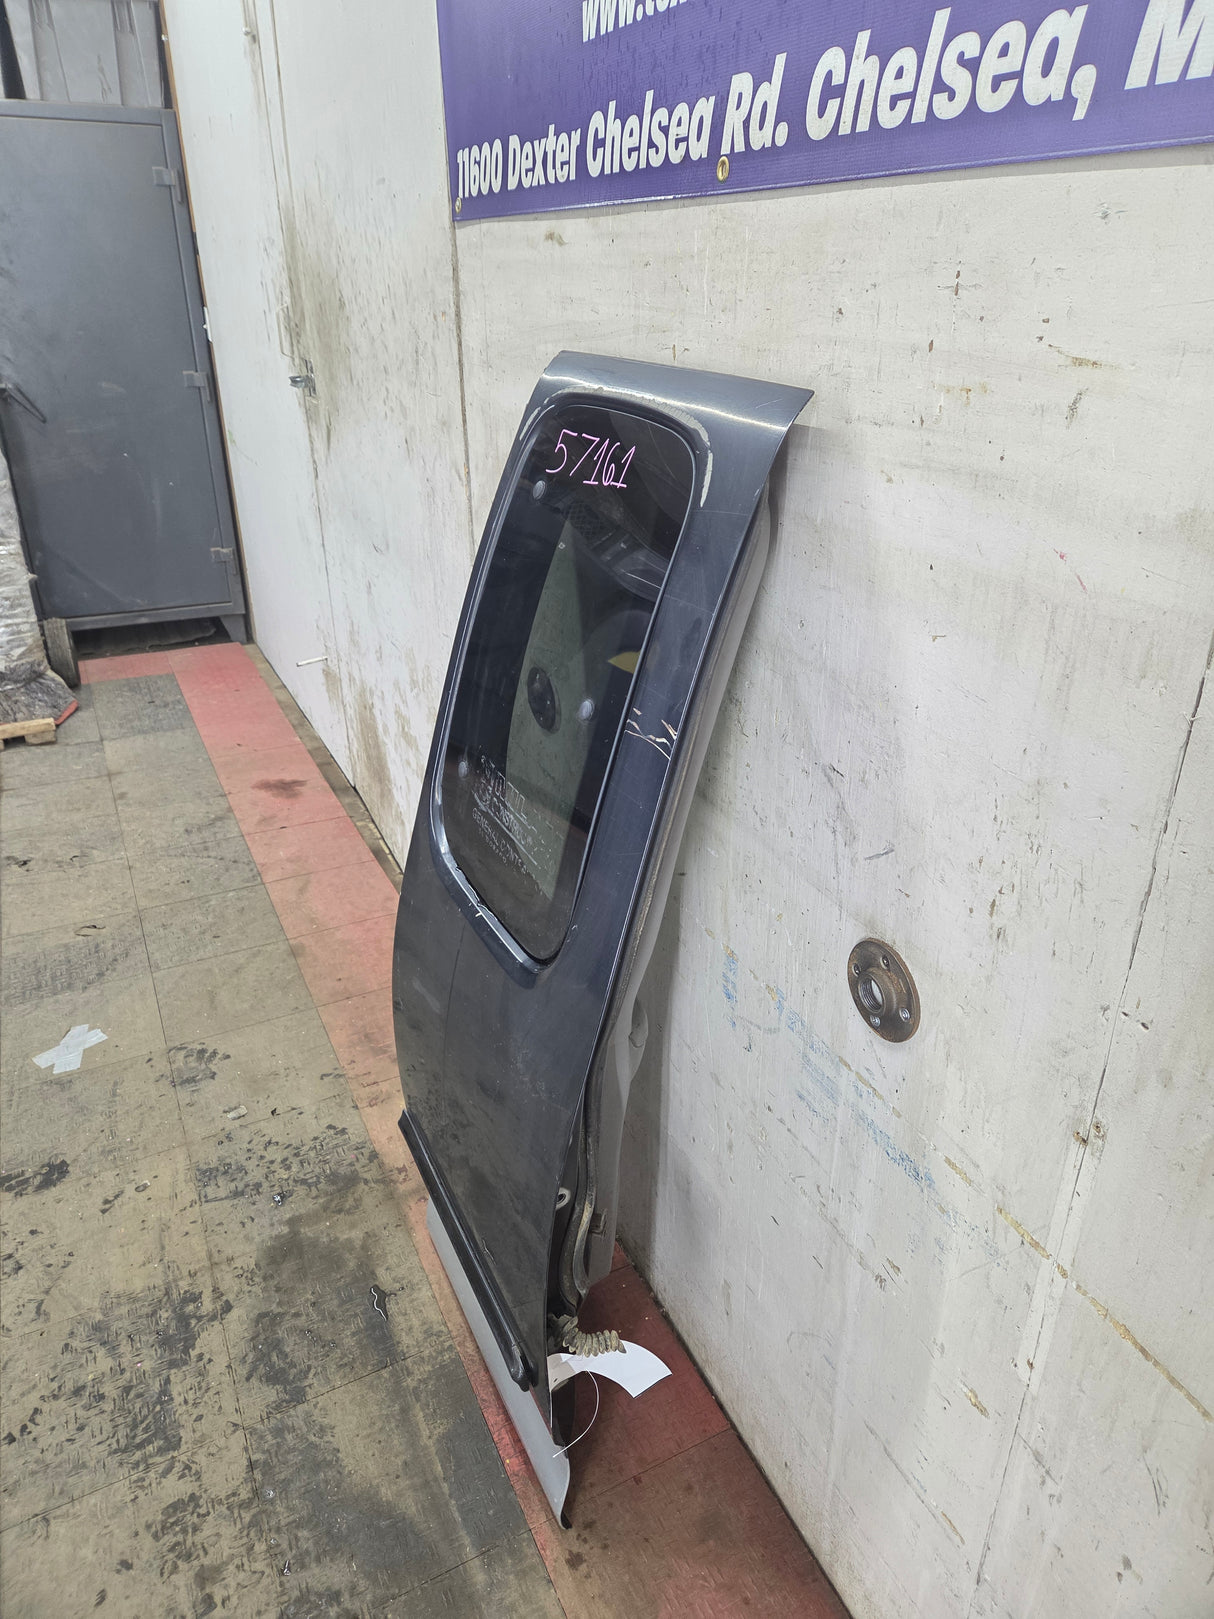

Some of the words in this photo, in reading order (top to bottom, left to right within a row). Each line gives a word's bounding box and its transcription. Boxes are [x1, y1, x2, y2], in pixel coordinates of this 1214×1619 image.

[457, 138, 503, 198] 11600
[507, 124, 581, 190] Dexter
[586, 89, 716, 177] Chelsea
[720, 52, 789, 155] Rd.
[805, 4, 1098, 141] Chelsea,
[545, 428, 636, 488] 57161
